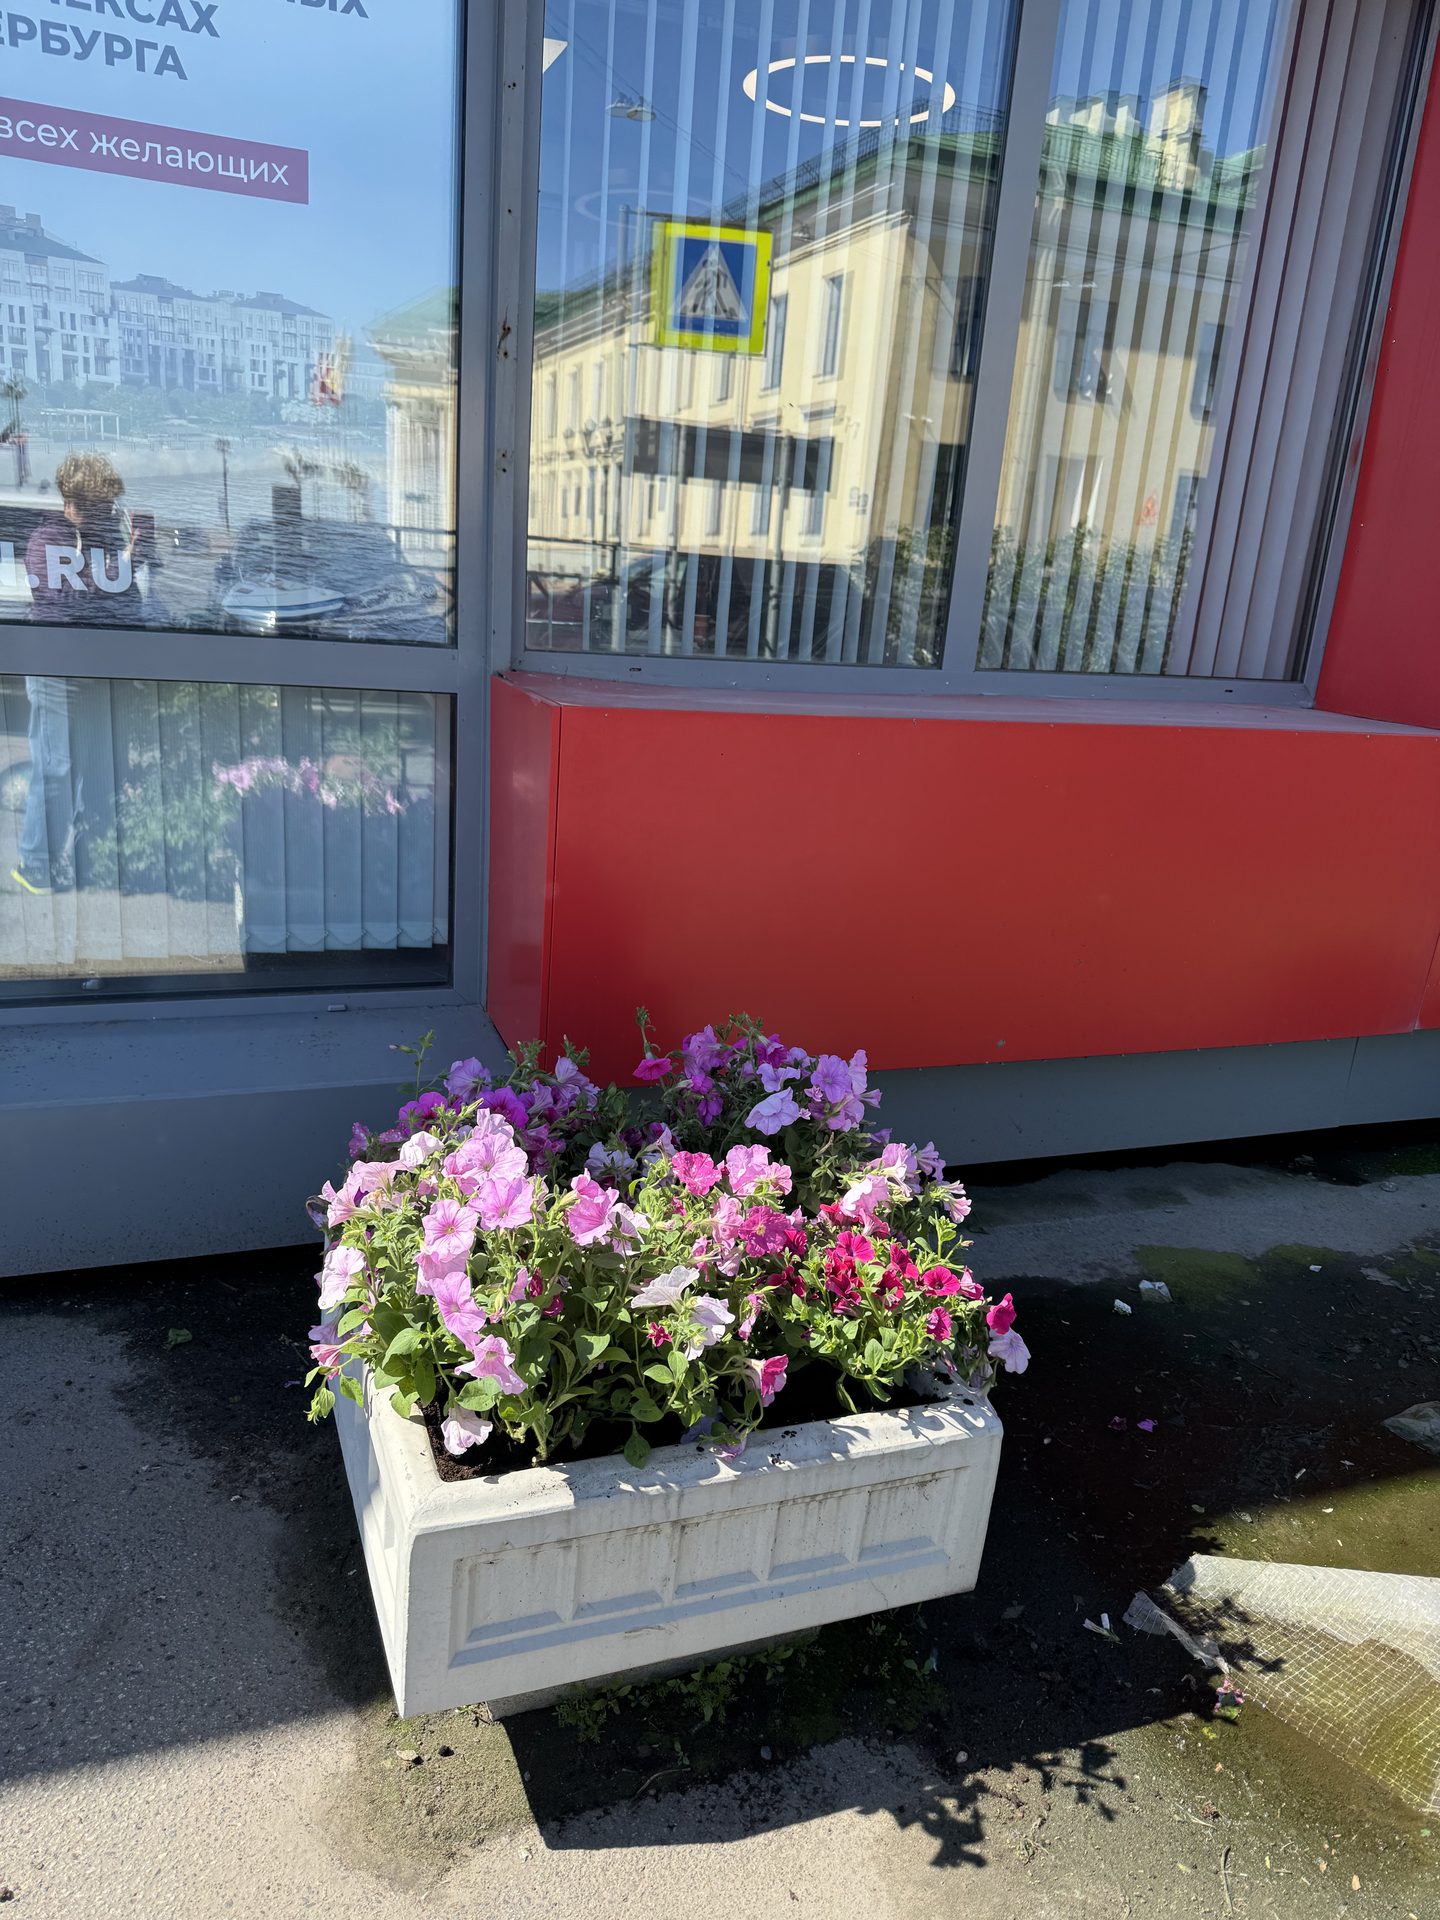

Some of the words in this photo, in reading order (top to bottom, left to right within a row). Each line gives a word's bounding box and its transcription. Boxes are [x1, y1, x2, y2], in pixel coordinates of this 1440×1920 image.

[0, 10, 188, 81] РБУРГА
[50, 0, 220, 38] САХ
[0, 115, 79, 151] всех
[89, 131, 290, 186] желающих
